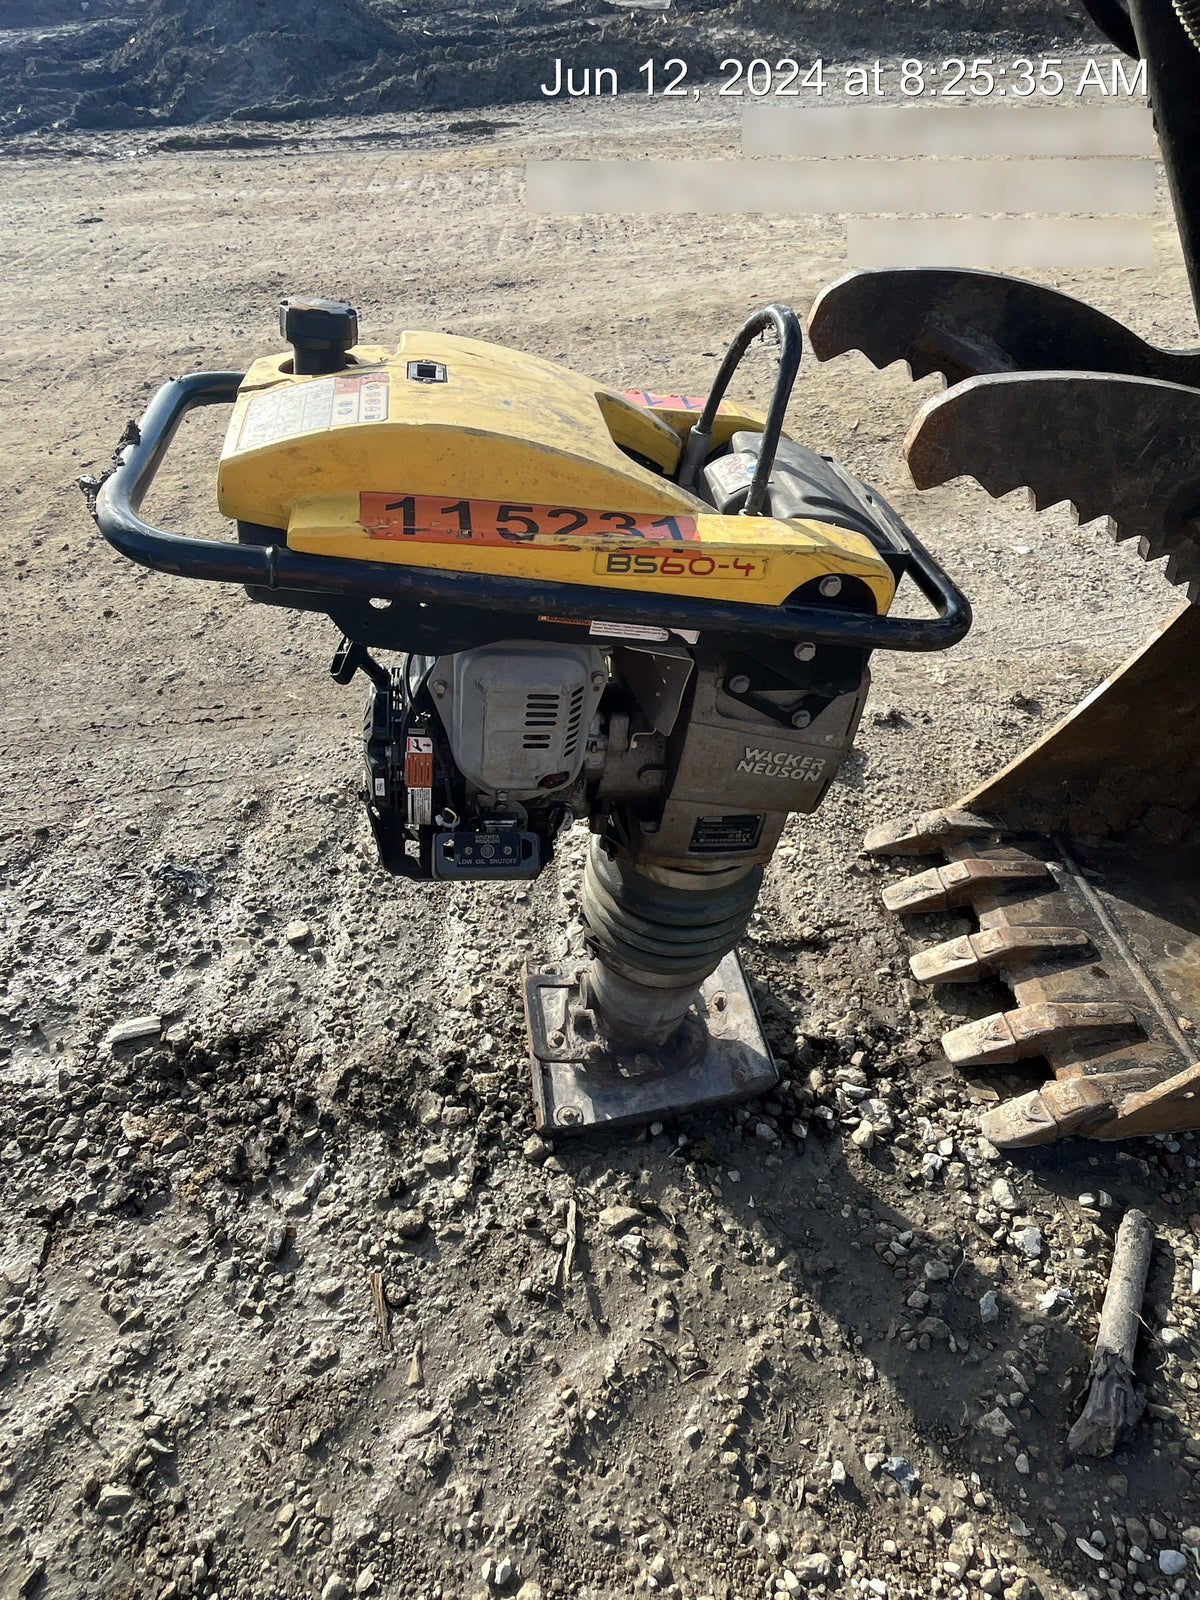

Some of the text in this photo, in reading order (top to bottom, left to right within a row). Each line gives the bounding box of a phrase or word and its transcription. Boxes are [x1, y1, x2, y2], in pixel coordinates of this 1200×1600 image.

[385, 496, 684, 553] 115231
[606, 553, 756, 577] BS60-4
[737, 760, 821, 782] NEUSON
[745, 747, 826, 771] WACKER
